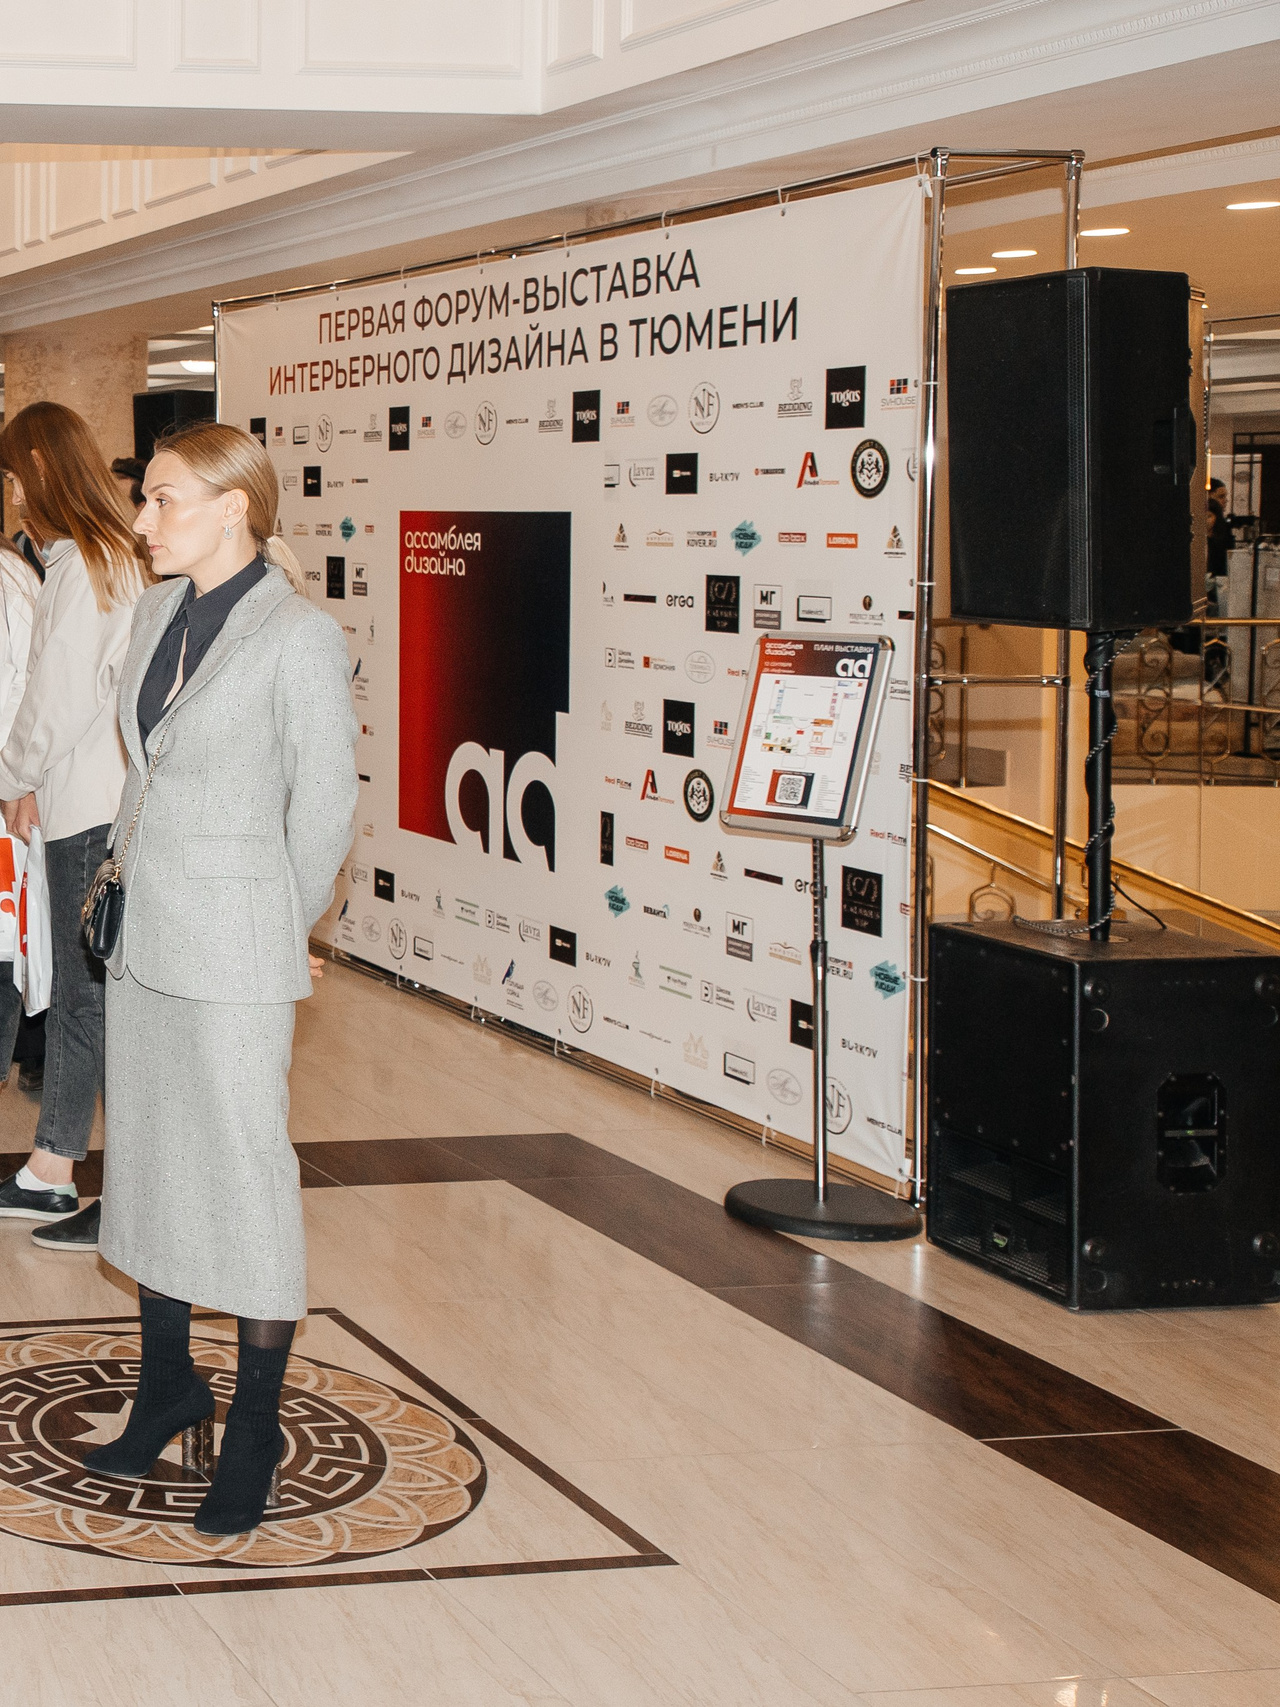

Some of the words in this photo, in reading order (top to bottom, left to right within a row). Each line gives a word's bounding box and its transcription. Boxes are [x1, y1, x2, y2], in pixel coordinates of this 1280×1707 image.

[319, 300, 406, 345] ПЕРВАЯ
[413, 248, 700, 332] ФОРУМ-ВЫСТАВКА
[269, 346, 441, 396] ИНТЕРЬЕРНОГО
[447, 323, 589, 384] ДИЗАЙНА
[600, 322, 619, 362] В
[629, 296, 799, 359] ТЮМЕНИ
[405, 525, 481, 552] ассамблея
[835, 653, 874, 678] ad
